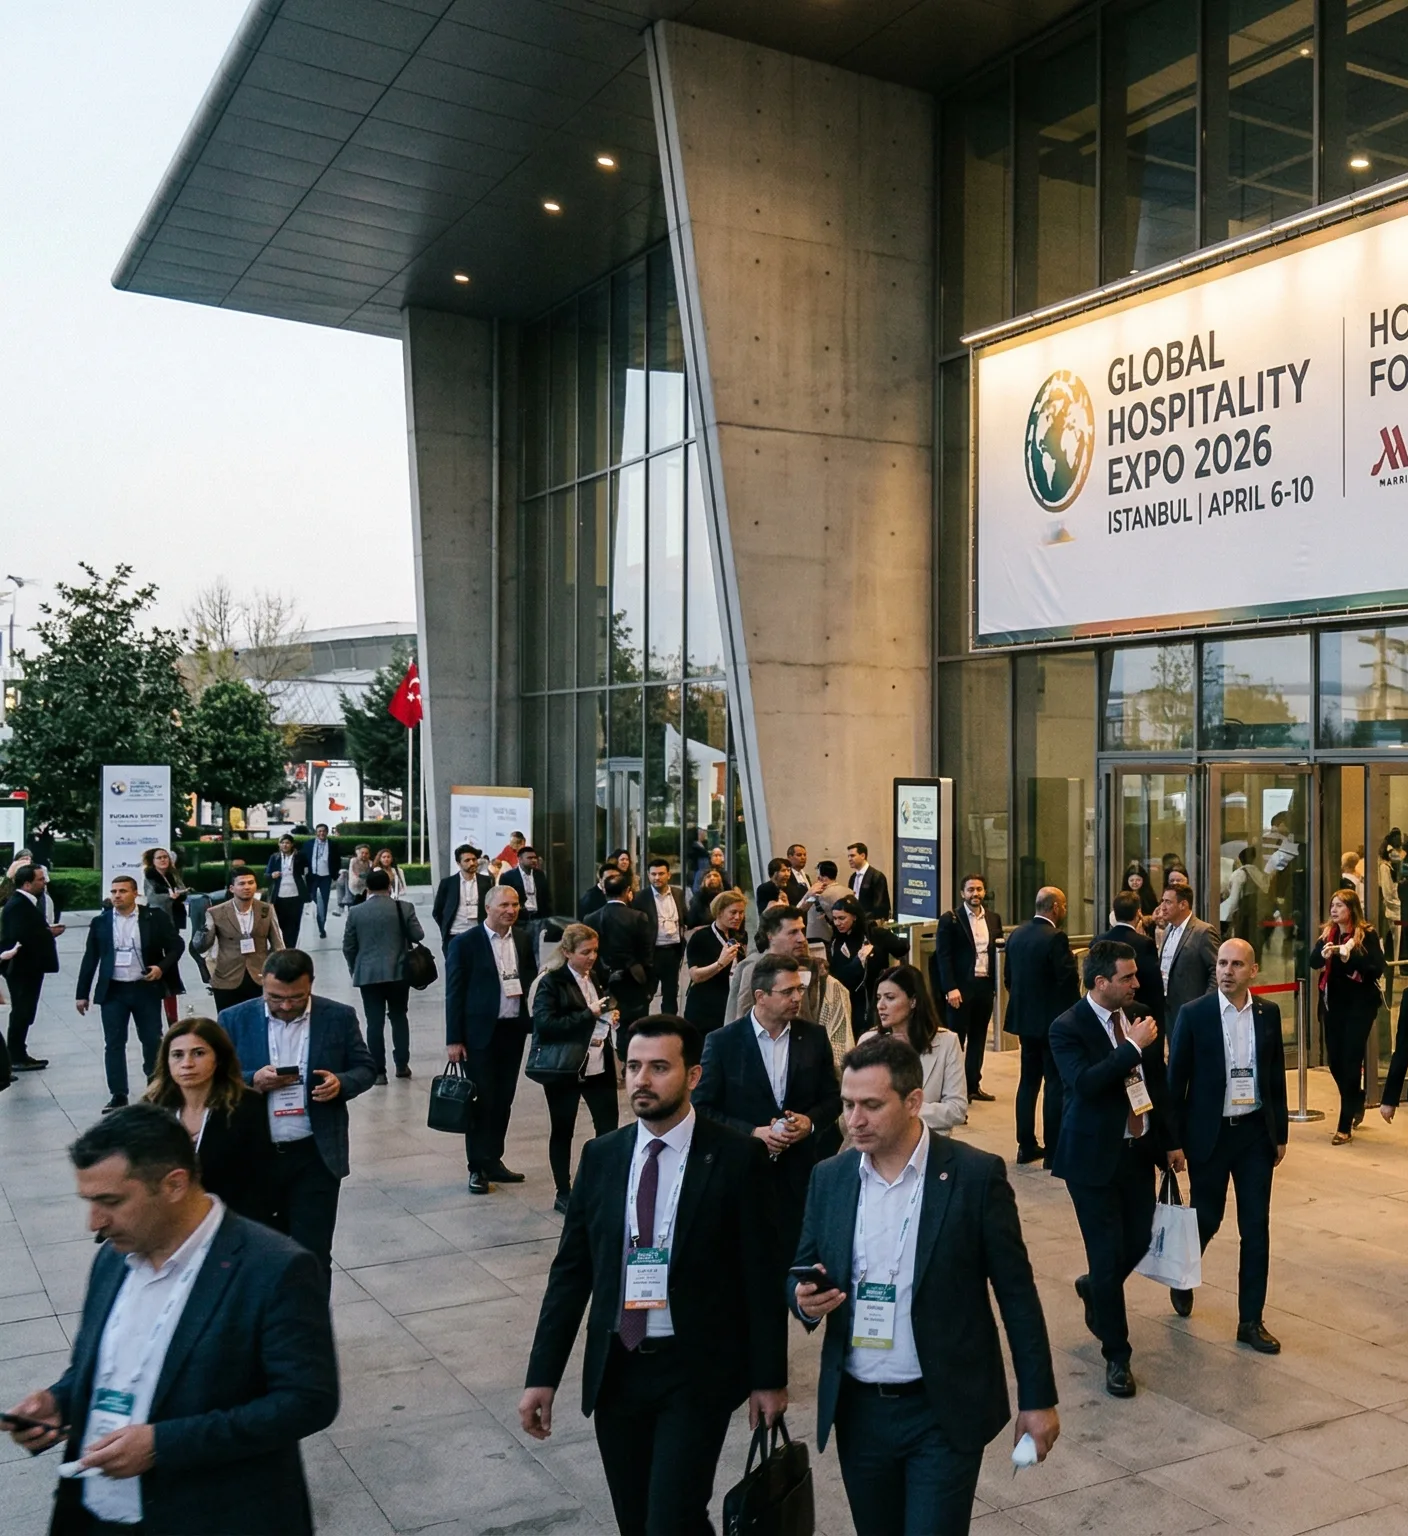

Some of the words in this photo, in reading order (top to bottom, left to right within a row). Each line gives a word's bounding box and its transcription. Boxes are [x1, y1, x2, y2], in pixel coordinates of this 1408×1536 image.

[1107, 330, 1225, 396] GLOBAL
[1108, 359, 1311, 446] HOSPITALITY
[1108, 444, 1185, 495] EXPO
[1194, 424, 1272, 479] 2026
[1108, 498, 1193, 534] ISTANBUL
[1208, 486, 1265, 518] APRIL
[1271, 475, 1314, 507] 6-10
